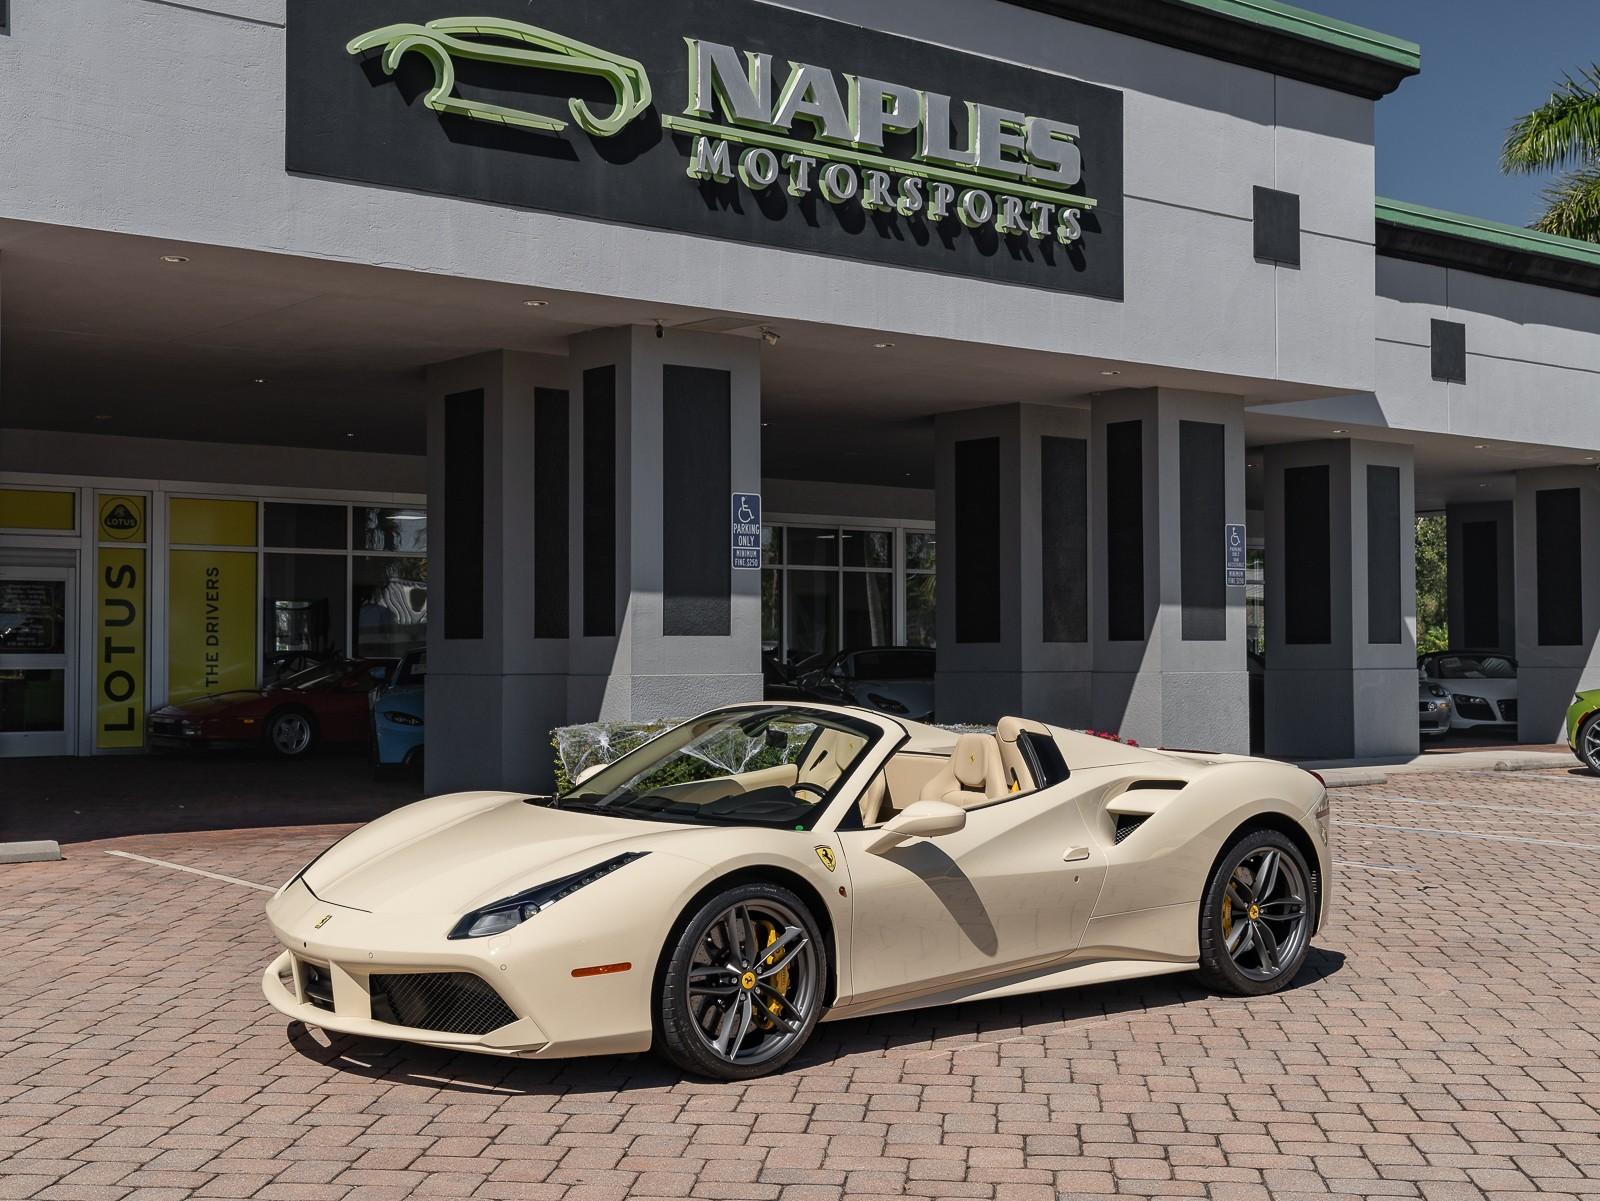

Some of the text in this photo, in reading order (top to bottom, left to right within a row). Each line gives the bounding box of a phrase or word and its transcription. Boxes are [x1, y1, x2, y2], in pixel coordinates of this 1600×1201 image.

[683, 37, 1080, 189] NAPLES
[688, 136, 1081, 243] MOTORSPORTS
[107, 518, 135, 526] LOTUS
[733, 524, 760, 534] PARKING
[738, 535, 755, 546] ONLY
[736, 549, 757, 557] MINIMUM
[104, 564, 136, 732] LOTUS
[206, 567, 220, 688] THE DRIVERS
